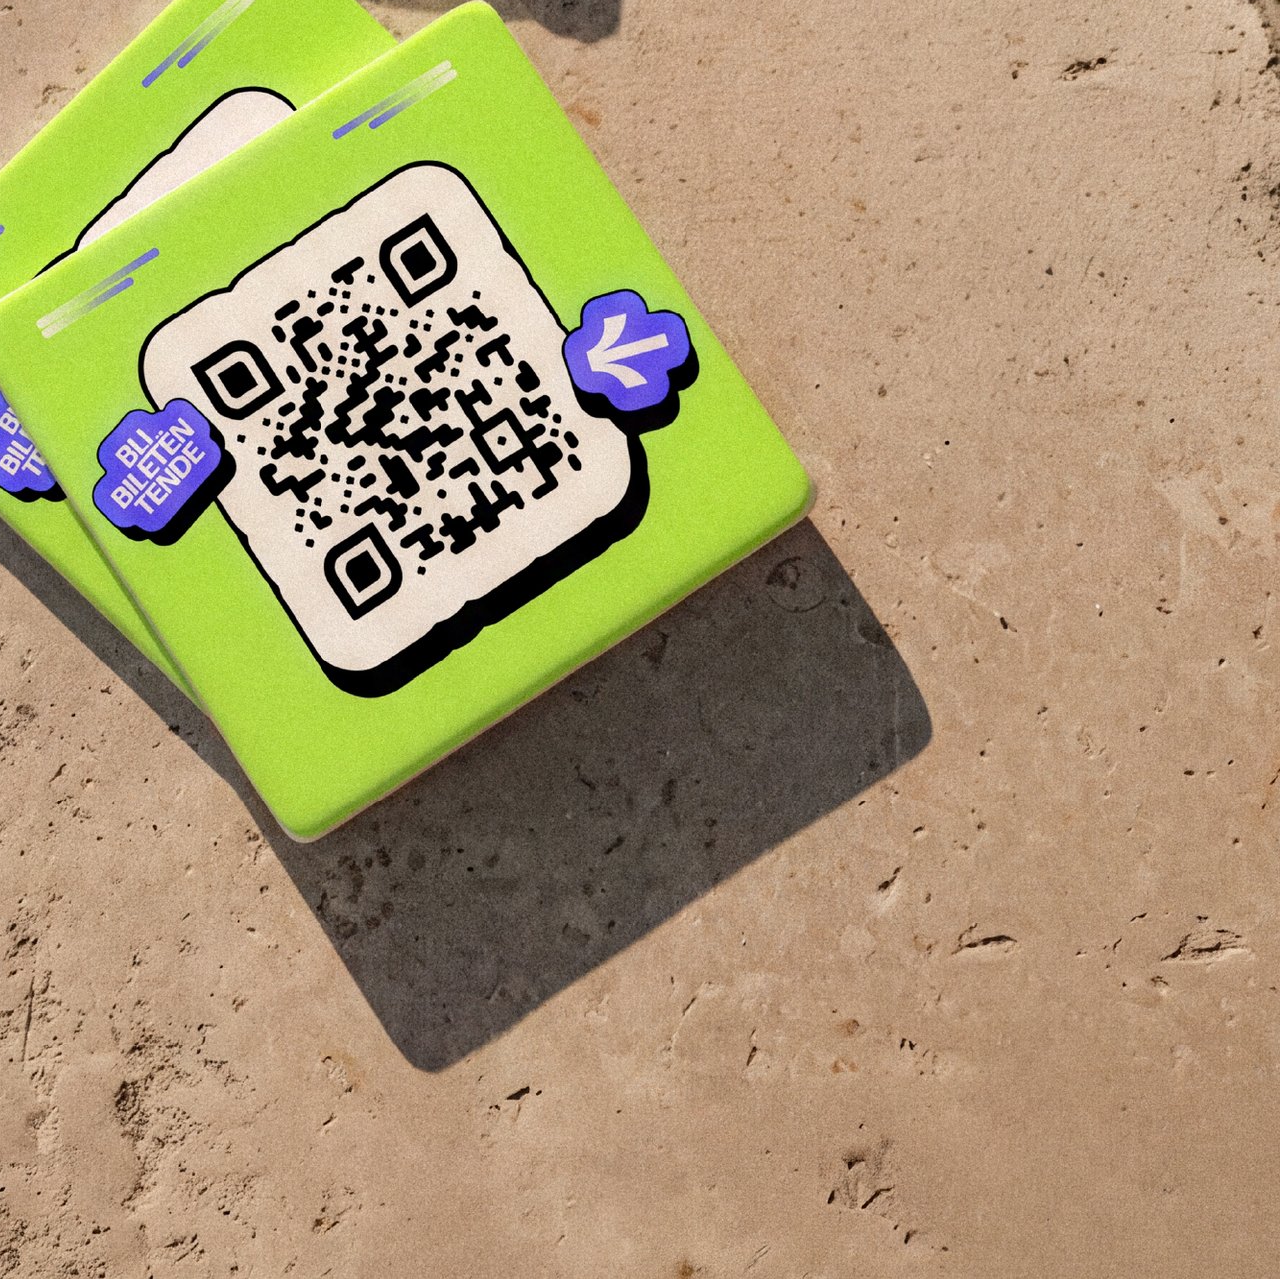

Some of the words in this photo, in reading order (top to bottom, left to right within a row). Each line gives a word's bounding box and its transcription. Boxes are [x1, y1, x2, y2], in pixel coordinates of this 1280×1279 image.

[110, 417, 195, 509] BILETËN
[115, 428, 153, 468] BLI
[134, 440, 206, 515] TENDE
